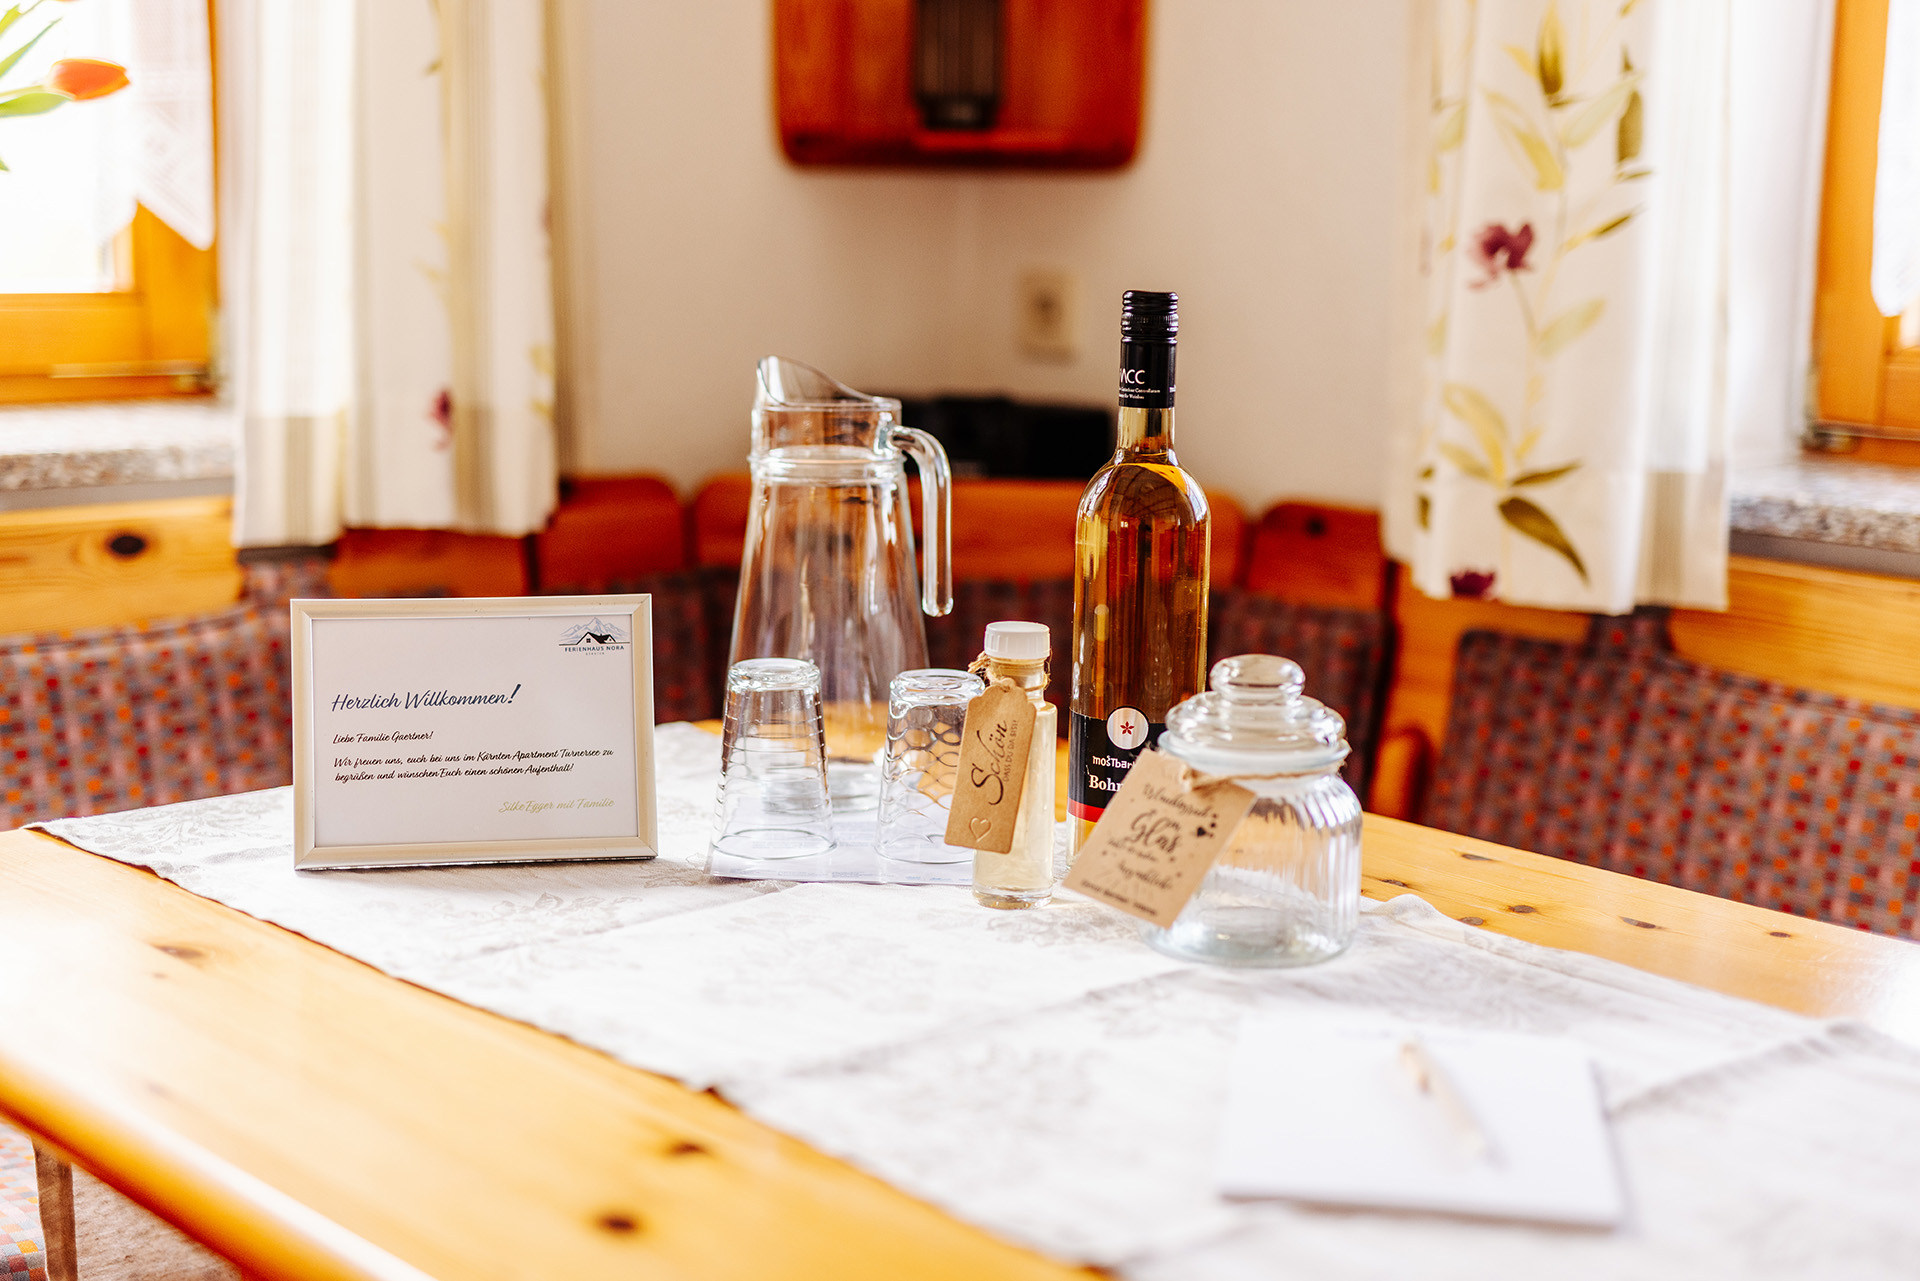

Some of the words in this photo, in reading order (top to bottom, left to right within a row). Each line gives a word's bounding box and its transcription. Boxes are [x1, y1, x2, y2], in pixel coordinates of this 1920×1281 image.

[564, 645, 605, 653] FERIENHAUS
[331, 692, 401, 712] Herzlich
[404, 683, 522, 709] Willkommen!
[332, 734, 355, 744] Liebe
[356, 732, 390, 743] Familie
[391, 730, 434, 743] Gaertner!
[1007, 739, 1015, 750] DA
[334, 756, 352, 768] Wir
[353, 757, 382, 769] freuen
[384, 757, 403, 766] uns,
[406, 754, 428, 764] euch
[429, 753, 443, 763] bei
[444, 754, 461, 762] uns
[463, 753, 476, 762] im
[476, 751, 512, 762] Kärnten
[511, 750, 559, 762] Apartment
[559, 748, 601, 759] Turnersee
[971, 719, 1008, 806] Schön
[1005, 751, 1014, 763] DU
[1092, 755, 1135, 769] mostbar
[335, 771, 375, 784] begrüßen
[376, 770, 396, 780] und
[397, 768, 440, 779] wünschen
[439, 767, 463, 778] Euch
[464, 768, 488, 776] einen
[488, 766, 524, 776] schönen
[524, 762, 575, 776] Aufenthalt!
[1002, 763, 1011, 782] DASS
[498, 800, 526, 813] Silke
[525, 799, 554, 814] Egger
[556, 799, 575, 810] mit
[576, 797, 616, 810] Familie
